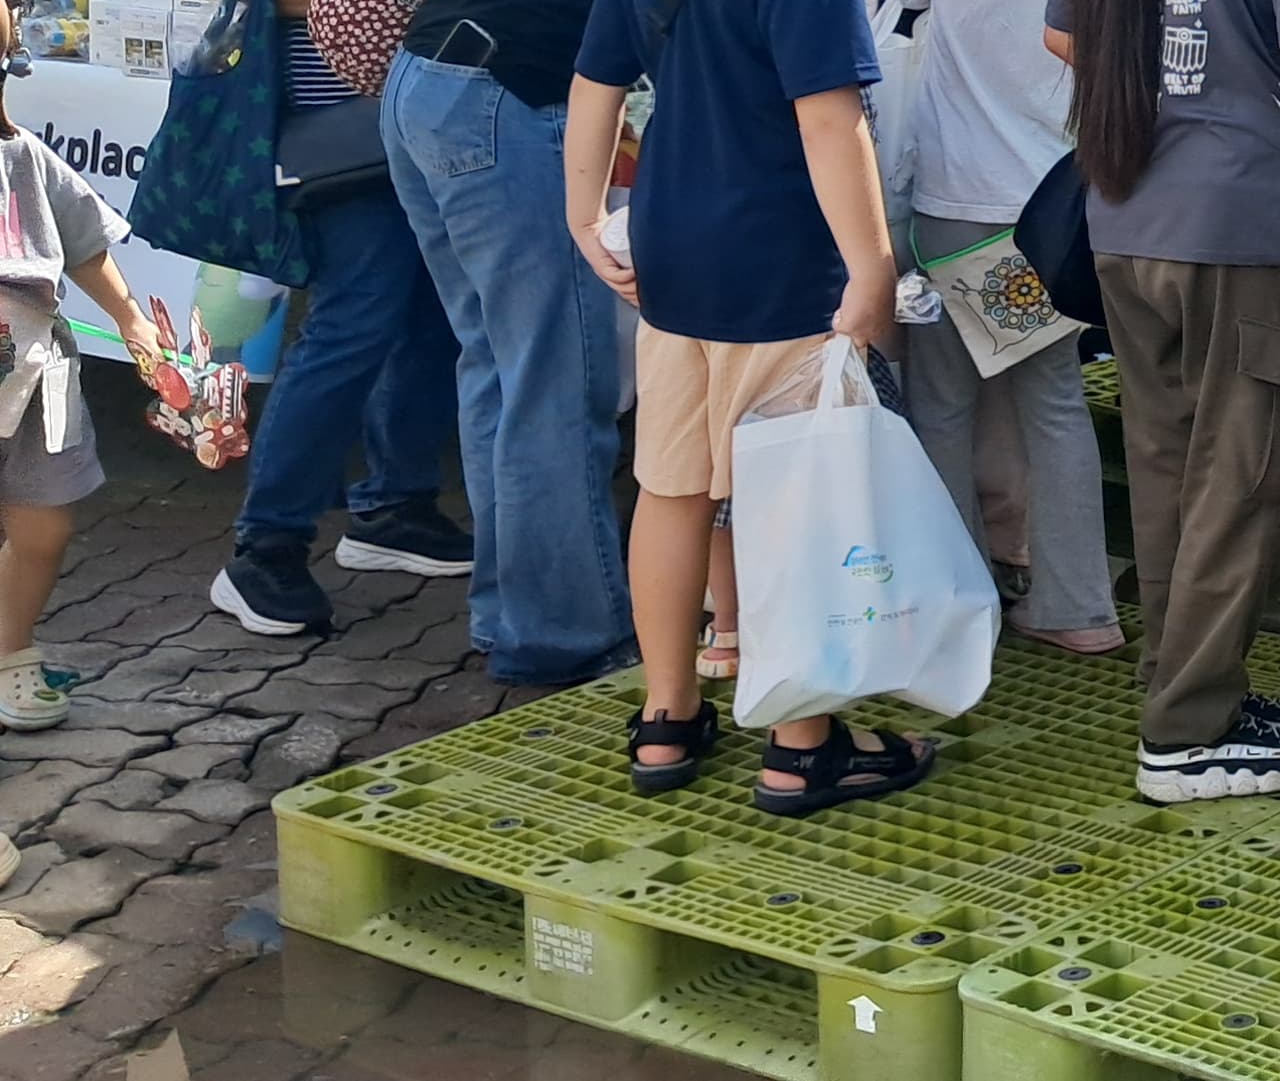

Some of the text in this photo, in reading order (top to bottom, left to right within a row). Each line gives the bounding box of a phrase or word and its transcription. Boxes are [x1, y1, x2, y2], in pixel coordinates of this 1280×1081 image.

[1172, 2, 1202, 16] FAITH
[1191, 72, 1206, 85] OF
[1167, 84, 1201, 96] TRUTH
[35, 121, 147, 181] kplac
